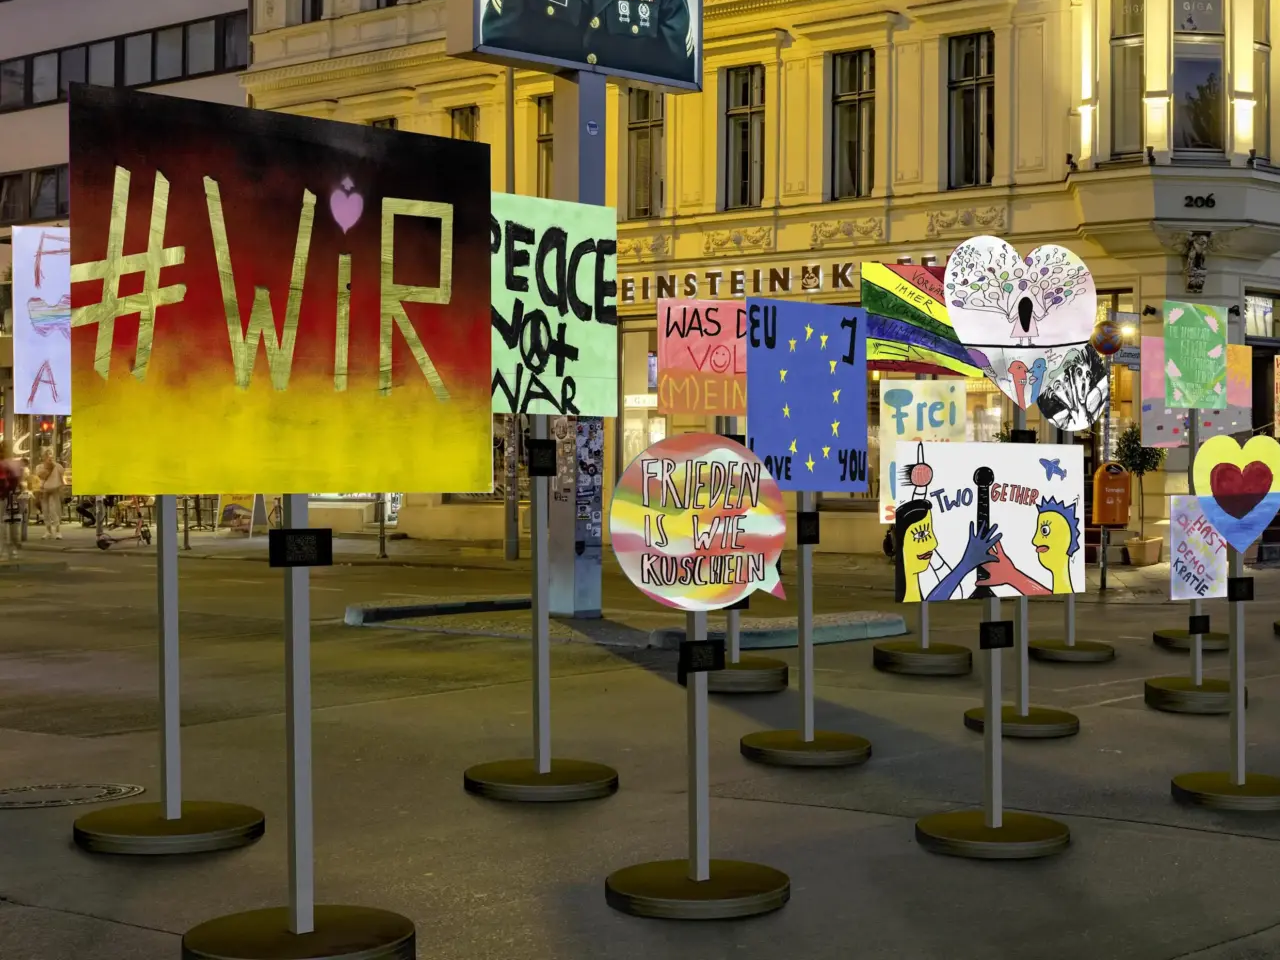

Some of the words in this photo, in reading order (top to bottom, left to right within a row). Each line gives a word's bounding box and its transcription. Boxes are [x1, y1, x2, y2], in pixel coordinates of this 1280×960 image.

[1184, 193, 1215, 208] 206
[621, 266, 791, 302] EINSTEIN
[894, 283, 934, 314] IMMER
[838, 448, 867, 482] YOU
[641, 458, 761, 510] FRIEDEN
[930, 487, 974, 513] TWO
[644, 514, 669, 548] IS
[691, 514, 748, 550] WIE
[641, 552, 765, 586] KUSCHELN
